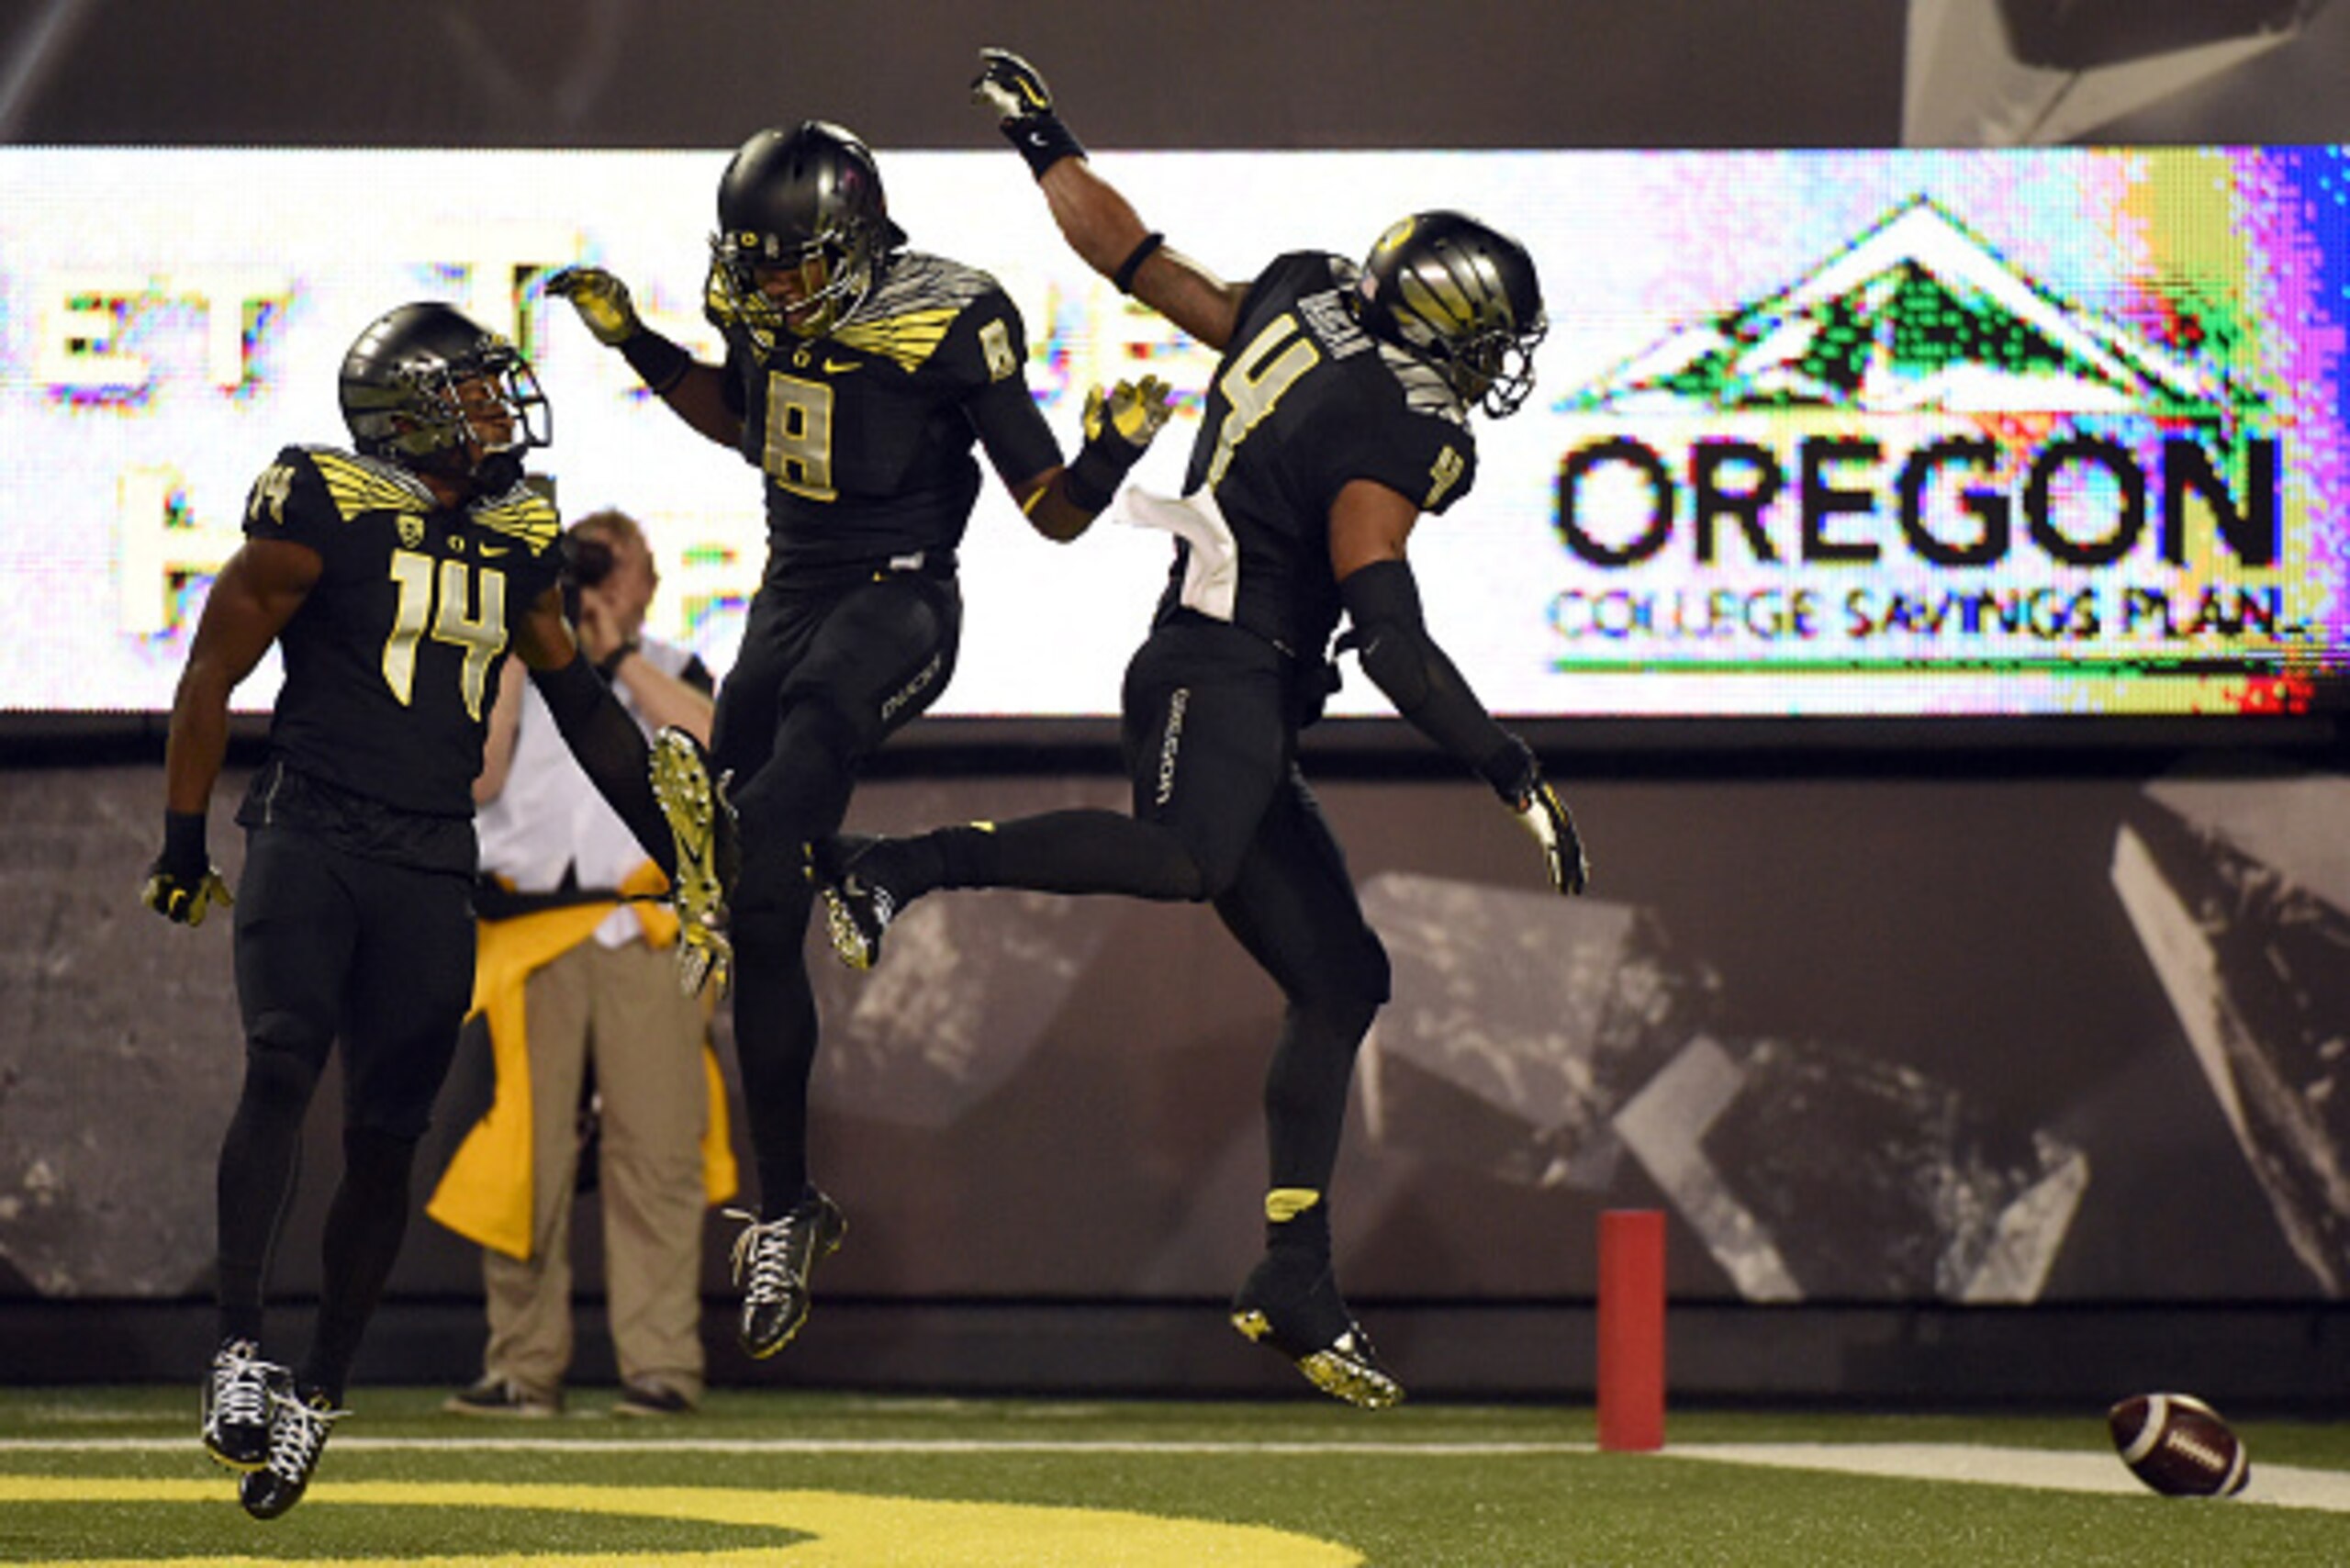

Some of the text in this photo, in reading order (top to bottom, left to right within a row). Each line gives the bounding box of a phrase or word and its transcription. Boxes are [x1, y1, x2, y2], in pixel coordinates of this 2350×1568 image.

[978, 318, 1016, 382] 8
[765, 369, 838, 502] 8
[1208, 311, 1320, 491] 4
[249, 465, 296, 525] 14
[1422, 445, 1464, 508] 4
[1550, 434, 2282, 569] OREGON
[382, 548, 509, 722] 14
[1546, 584, 2281, 641] COLLEGE SAVINGS PLAN
